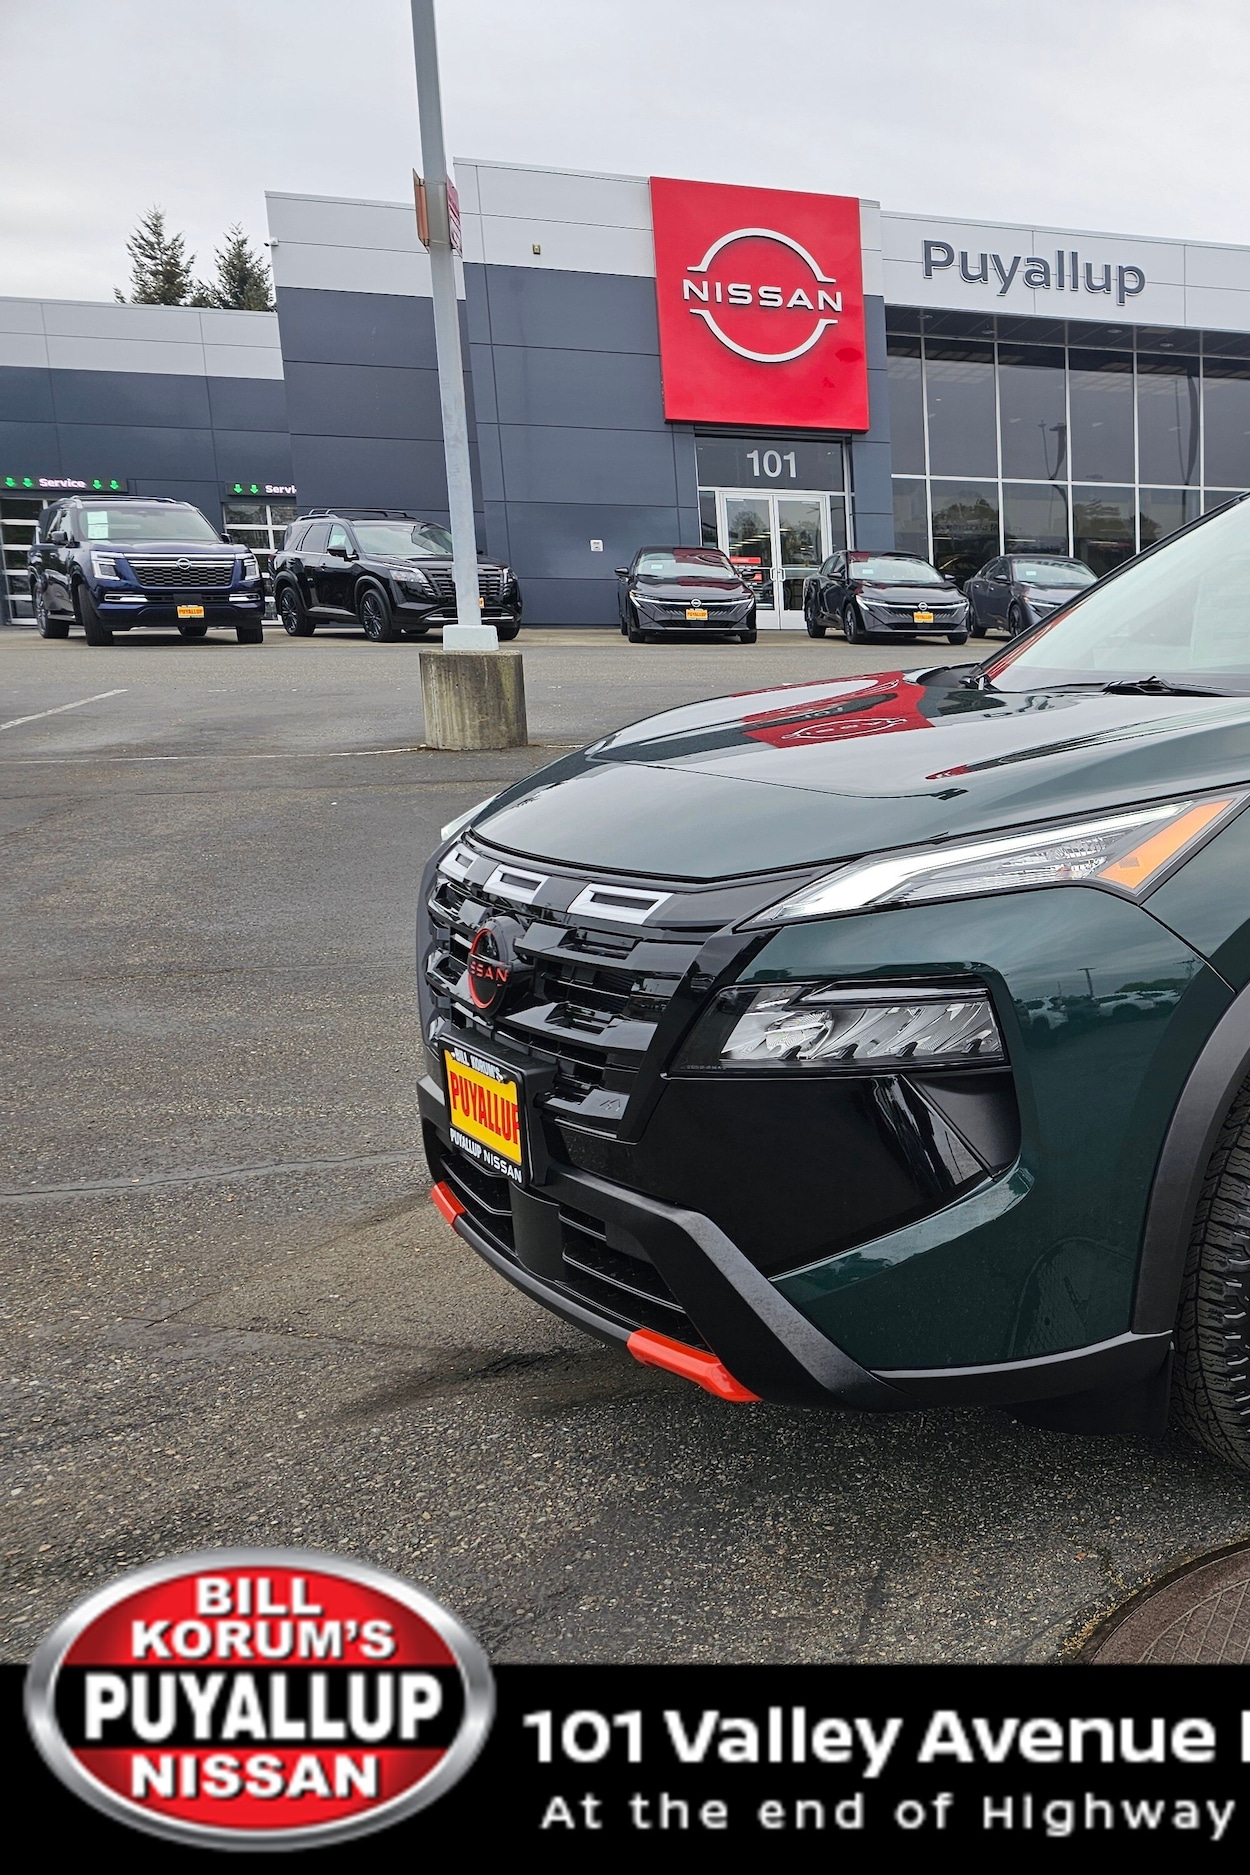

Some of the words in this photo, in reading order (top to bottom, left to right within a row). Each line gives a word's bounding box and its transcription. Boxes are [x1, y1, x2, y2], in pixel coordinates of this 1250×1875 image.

[922, 238, 1146, 305] Puyallup
[683, 276, 843, 313] NISSAN
[746, 448, 797, 478] 101
[39, 478, 87, 489] Service
[264, 484, 297, 494] Servi
[450, 1128, 481, 1159] PUYALLUP
[483, 1149, 523, 1184] NISSAN
